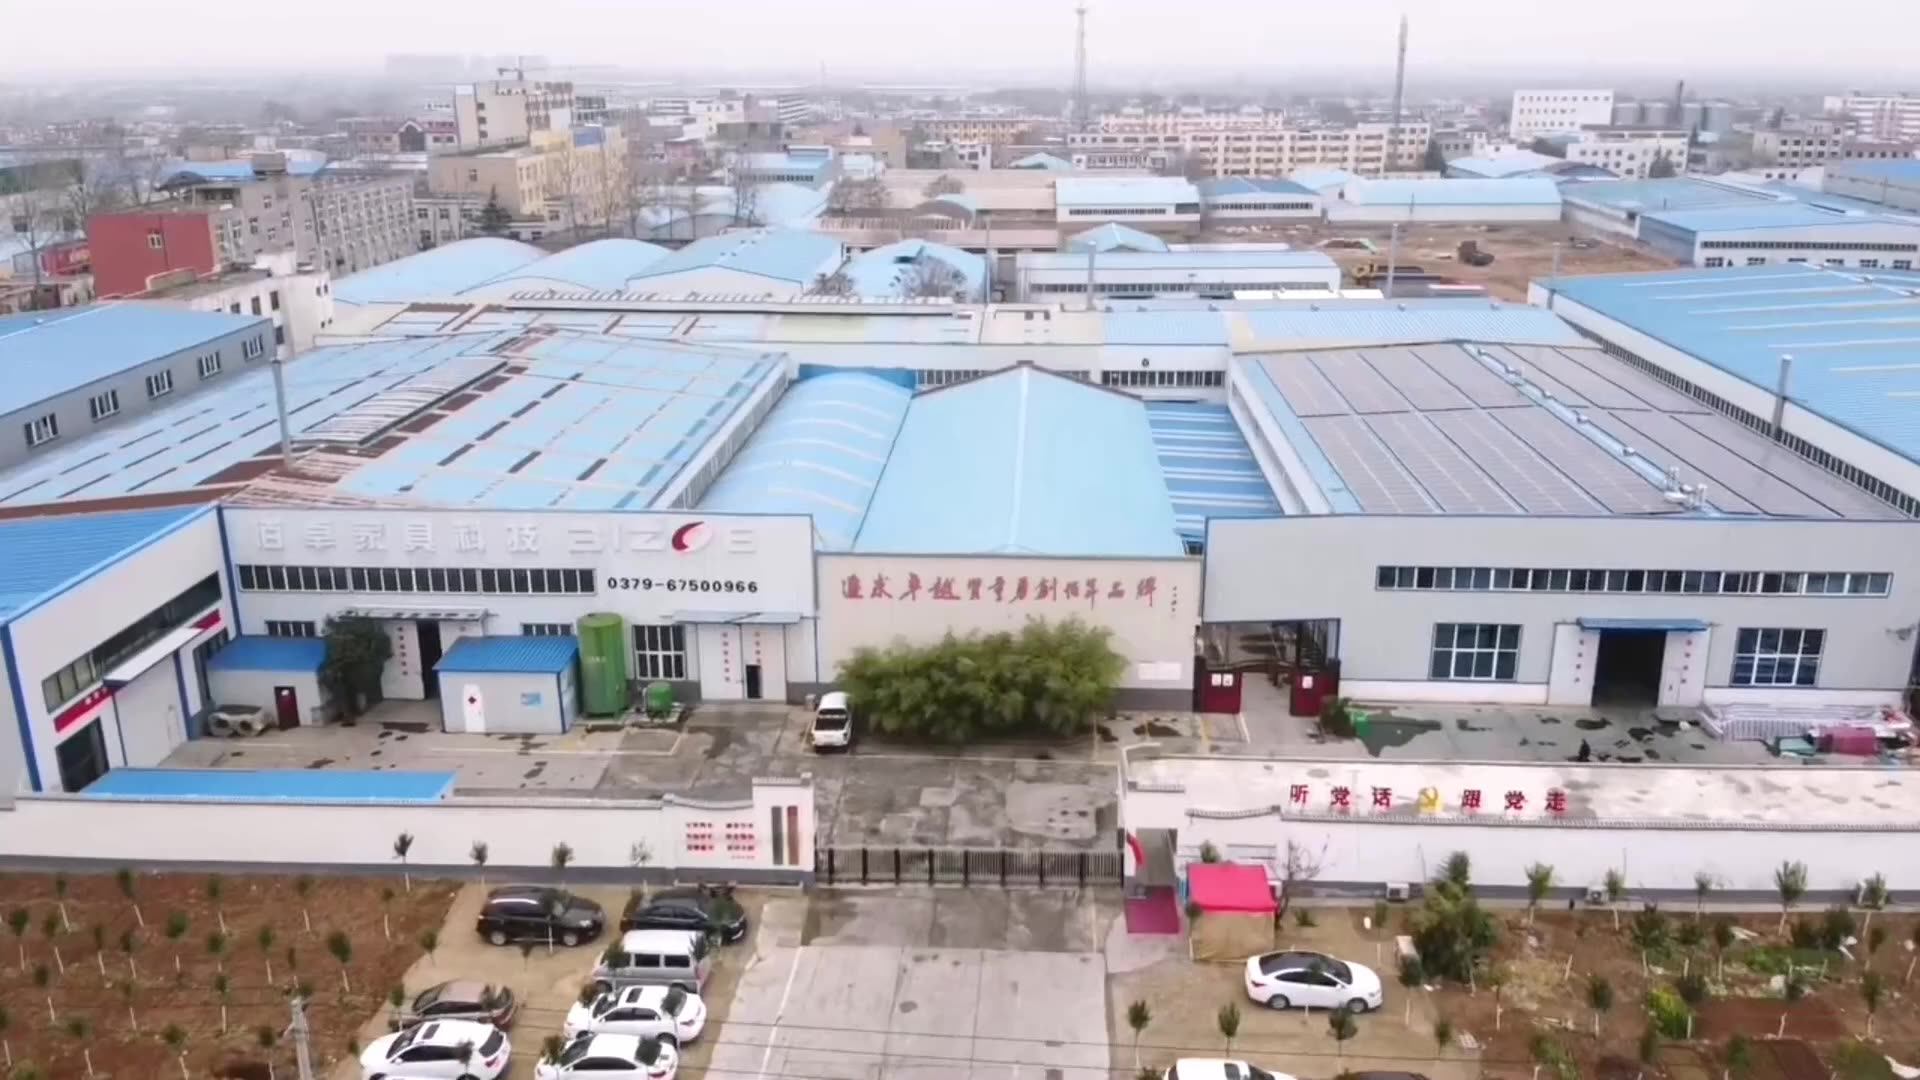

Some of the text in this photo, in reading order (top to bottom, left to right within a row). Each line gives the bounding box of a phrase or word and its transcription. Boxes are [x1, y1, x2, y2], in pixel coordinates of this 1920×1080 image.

[607, 576, 758, 593] 0379-67500966
[1289, 784, 1567, 812] 听党话 跟党走
